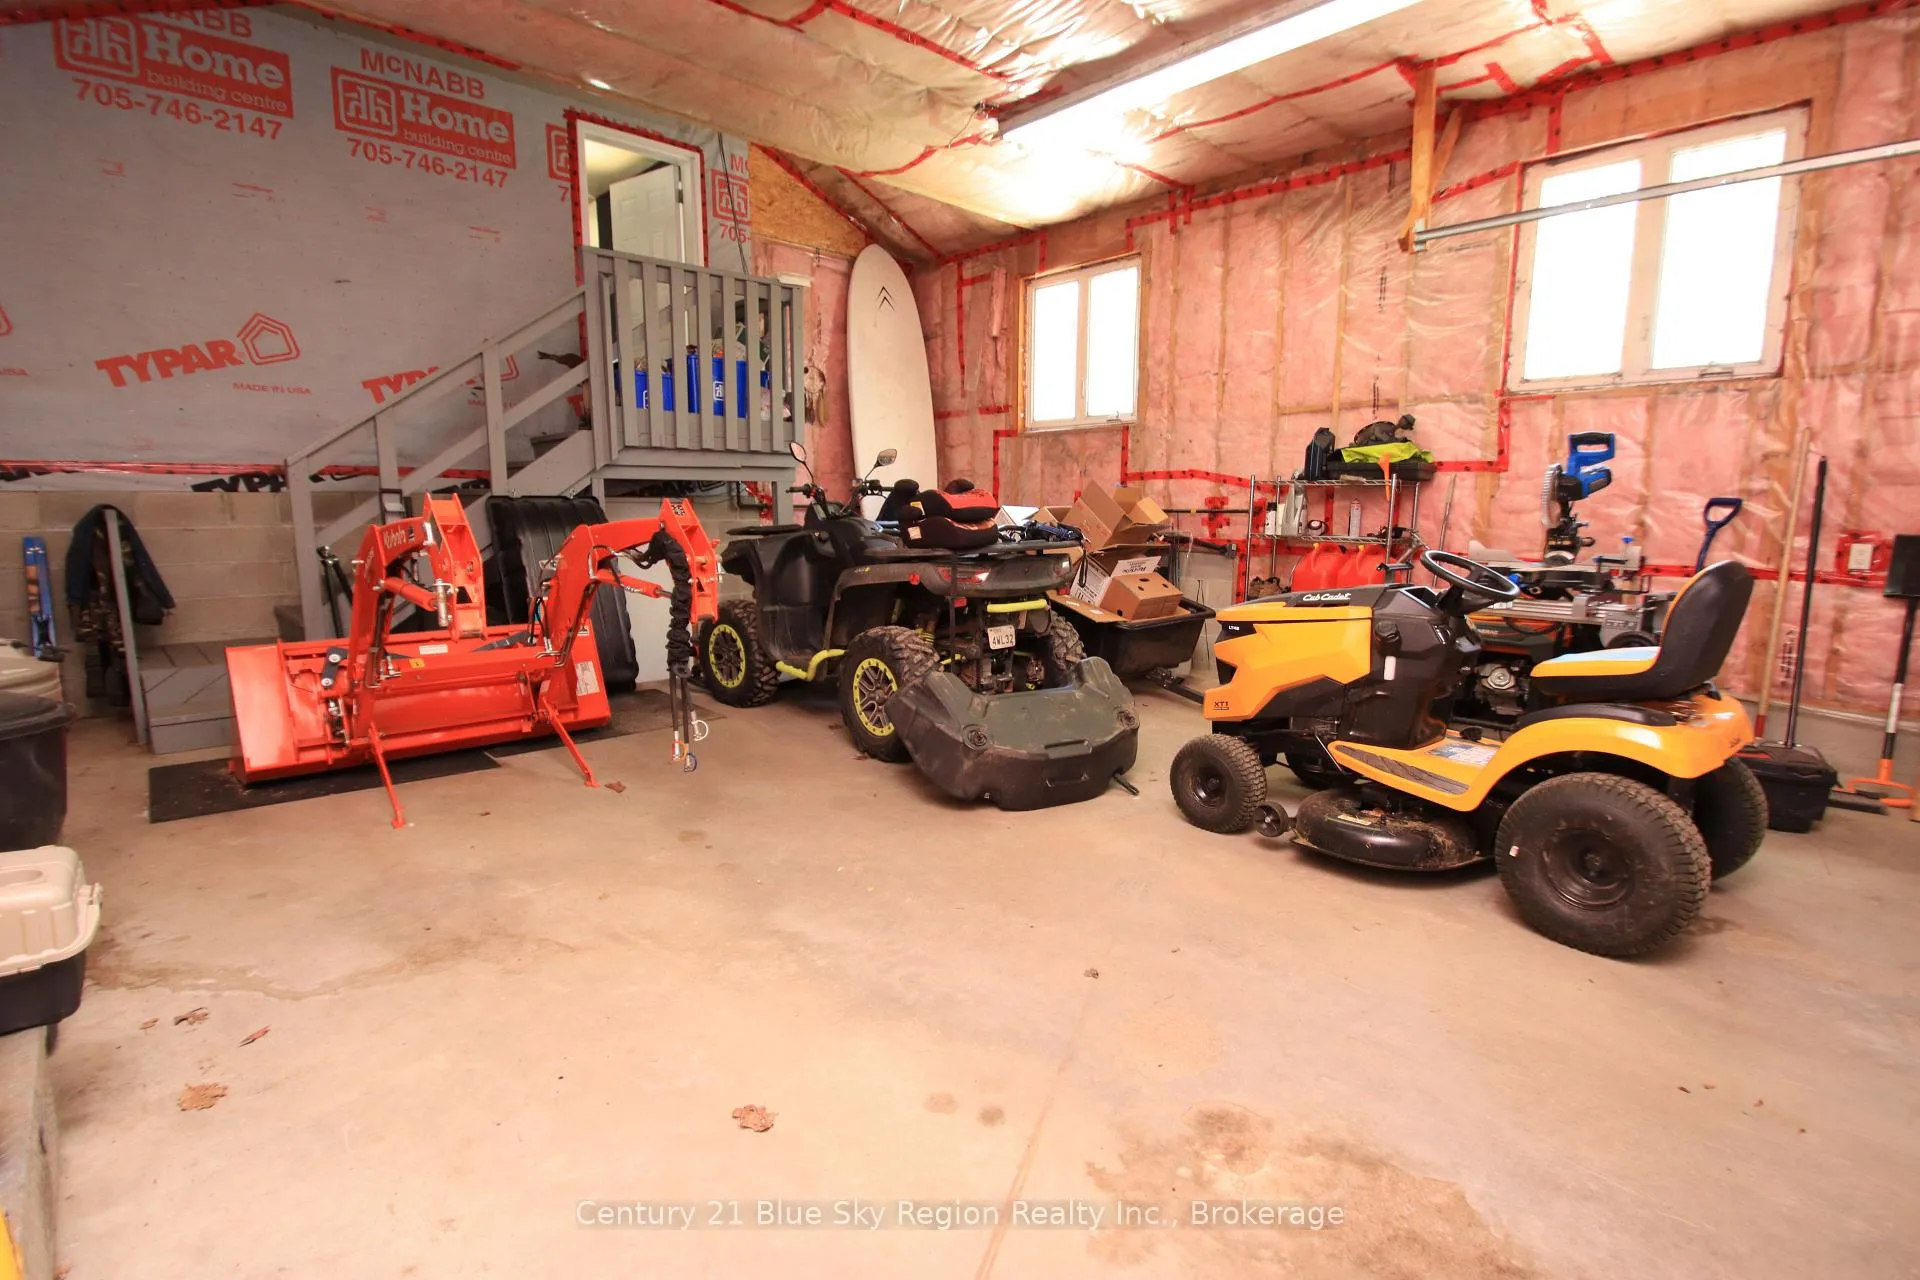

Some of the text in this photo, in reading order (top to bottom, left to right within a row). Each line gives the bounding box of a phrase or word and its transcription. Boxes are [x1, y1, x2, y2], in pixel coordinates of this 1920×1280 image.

[143, 23, 284, 89] Home
[72, 76, 283, 140] 705-746-2147
[145, 69, 288, 111] building centre
[400, 90, 509, 143] Home
[346, 138, 509, 188] 705-746-2147
[403, 128, 512, 163] building centre
[95, 339, 244, 388] TYPAR
[233, 382, 268, 392] MADE
[287, 386, 312, 396] USA
[1303, 592, 1352, 601] Cub Cadet
